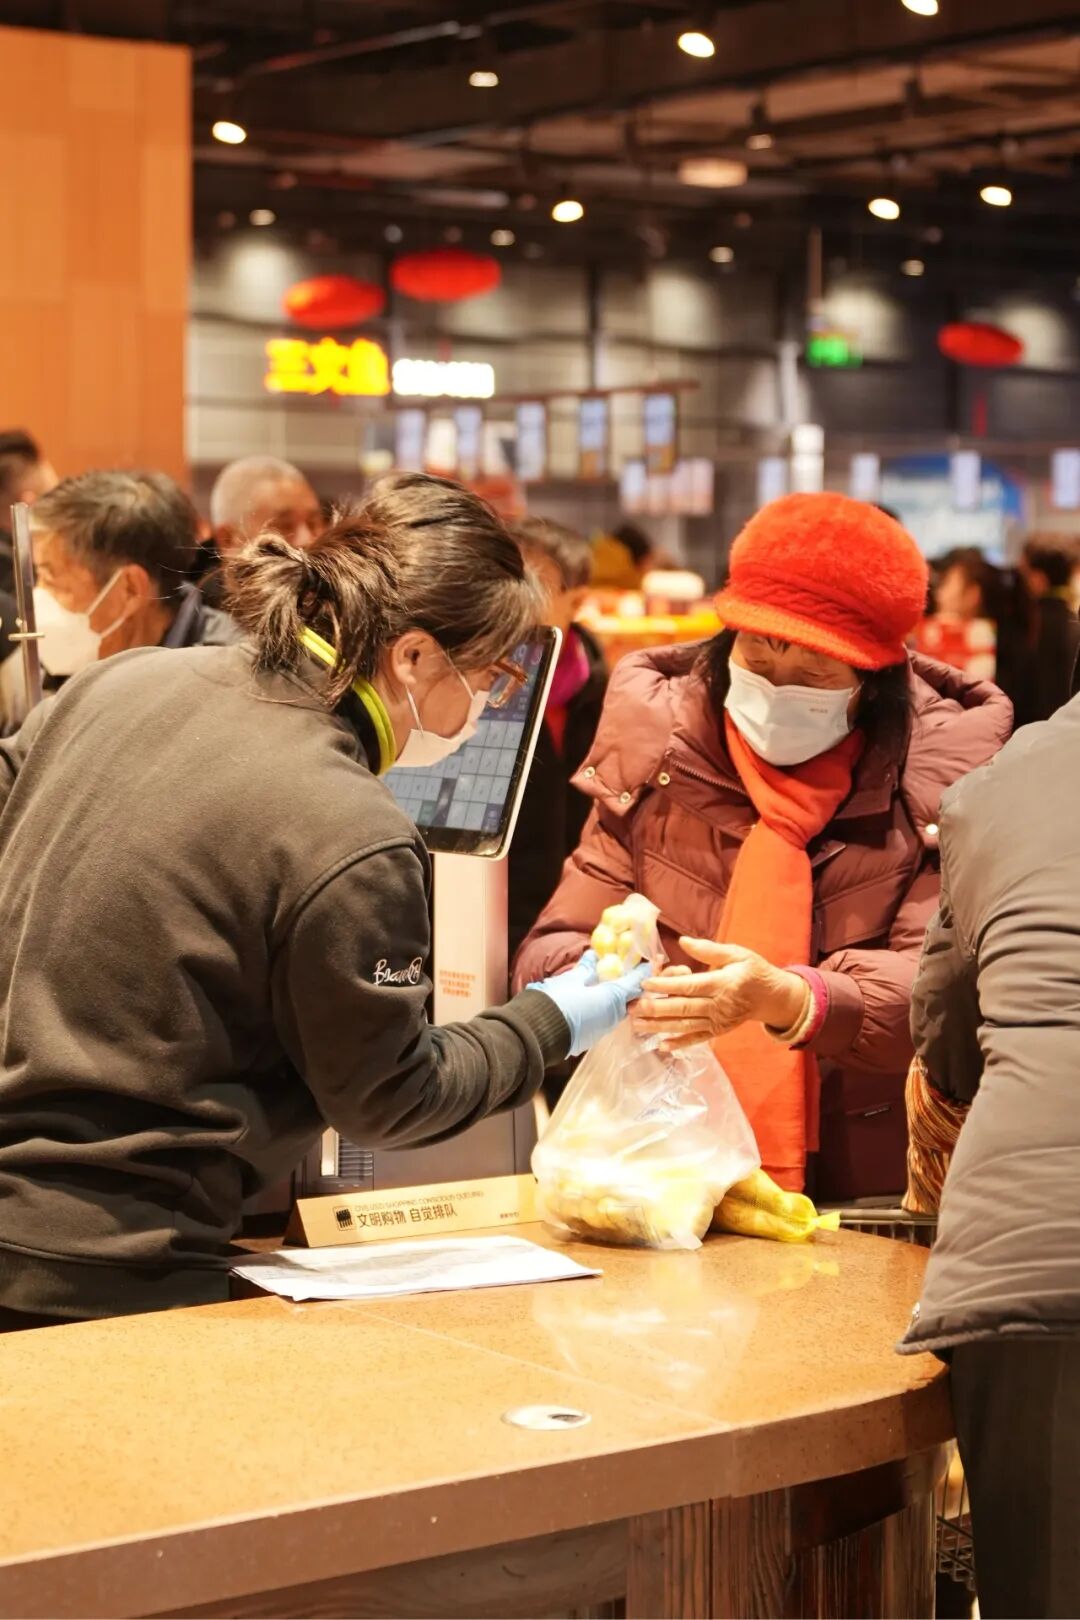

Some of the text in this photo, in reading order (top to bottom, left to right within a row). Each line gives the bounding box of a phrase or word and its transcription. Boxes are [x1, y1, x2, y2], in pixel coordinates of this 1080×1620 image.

[357, 1202, 458, 1228] 文明购物 自觉排队
